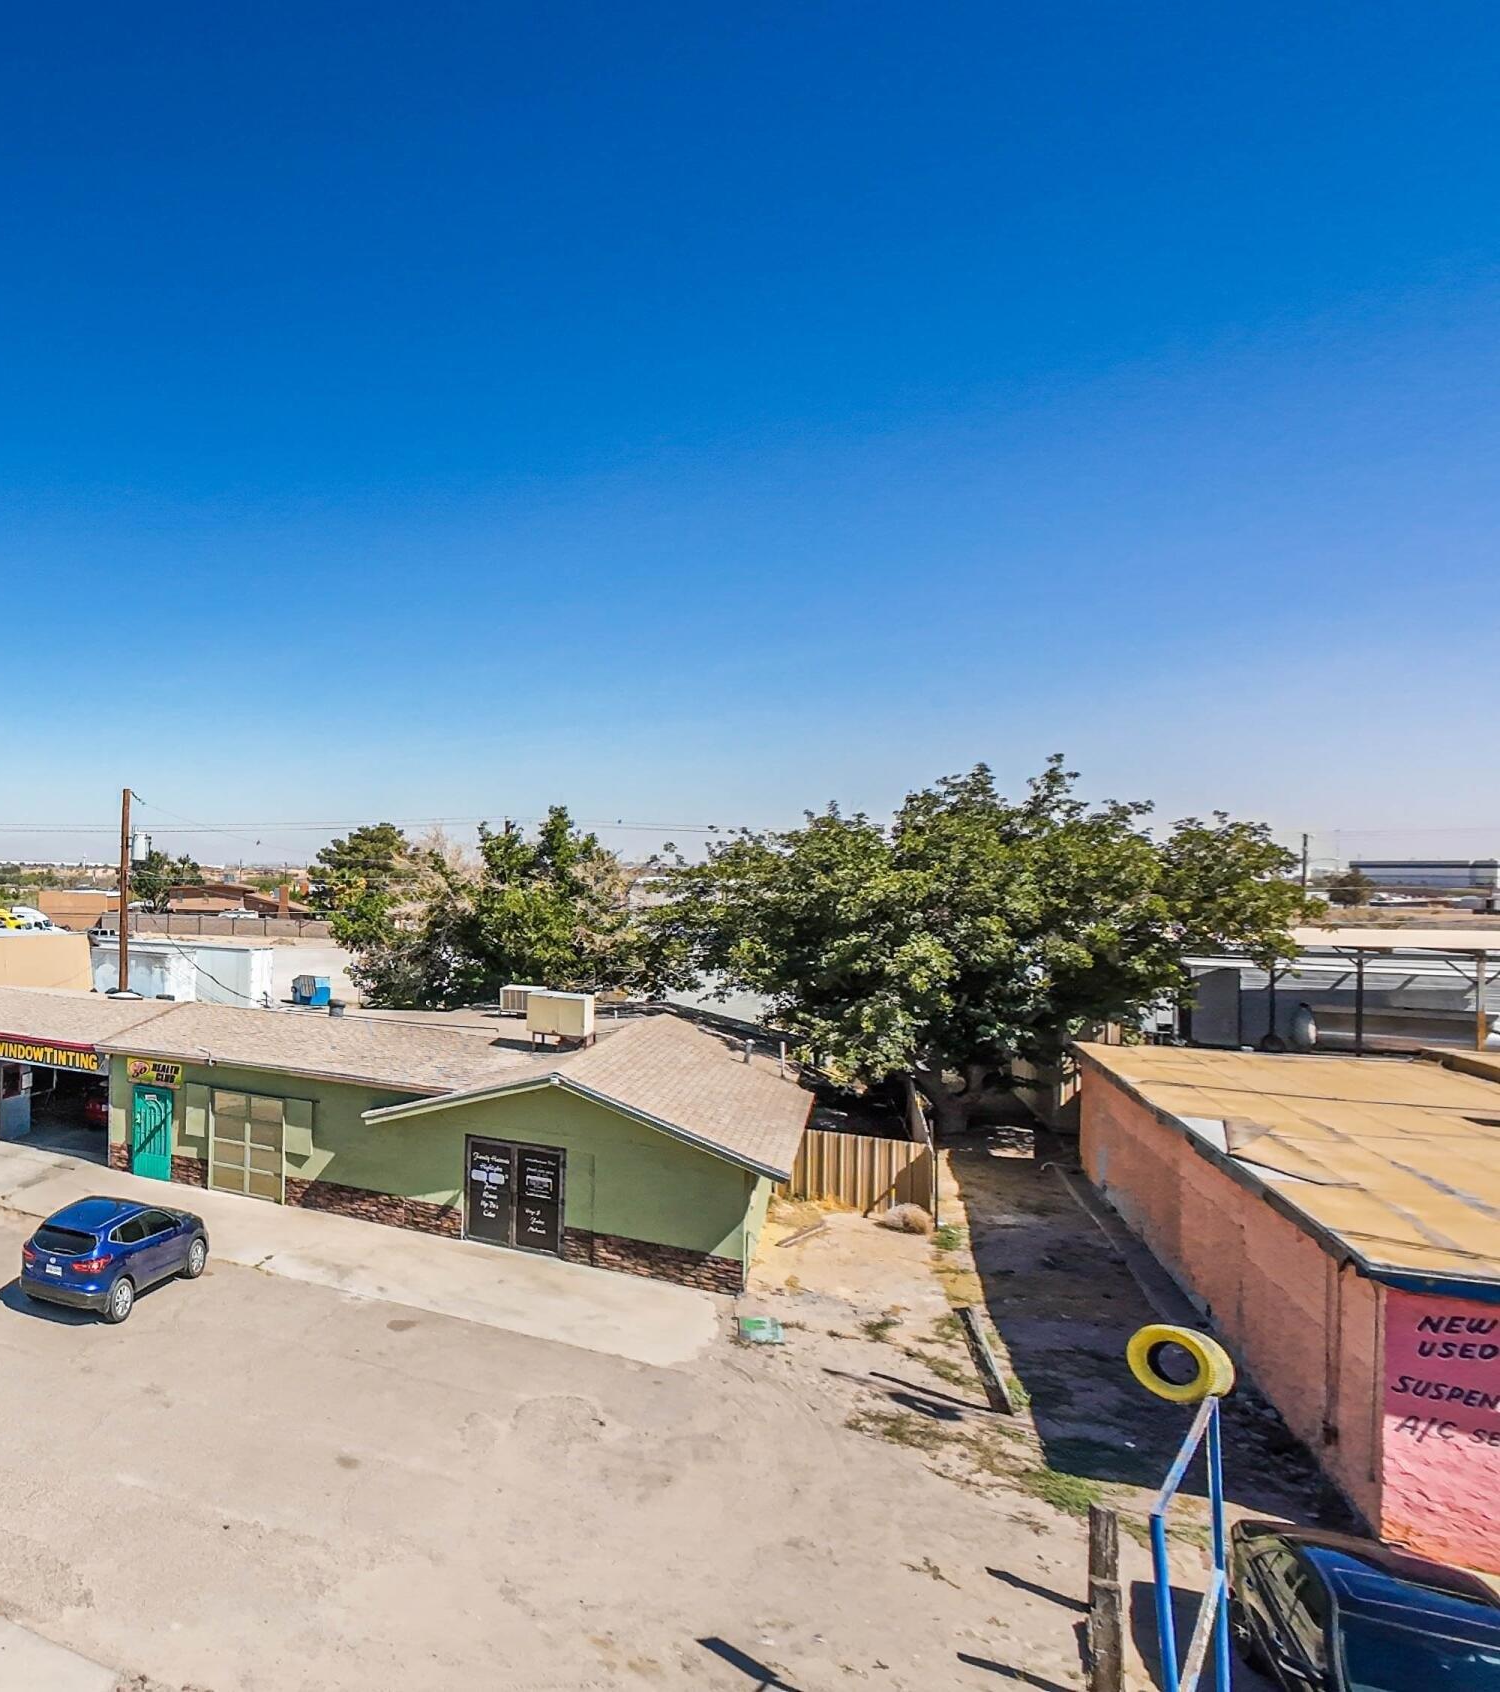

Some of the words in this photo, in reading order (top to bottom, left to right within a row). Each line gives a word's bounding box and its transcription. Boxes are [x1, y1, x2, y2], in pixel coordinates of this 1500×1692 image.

[151, 1063, 180, 1075] HEALTH
[155, 1073, 176, 1083] CLUB
[1416, 1315, 1499, 1335] NEW
[1418, 1341, 1500, 1360] USED
[1391, 1375, 1500, 1410] SUSPEN
[1394, 1415, 1458, 1443] A/C
